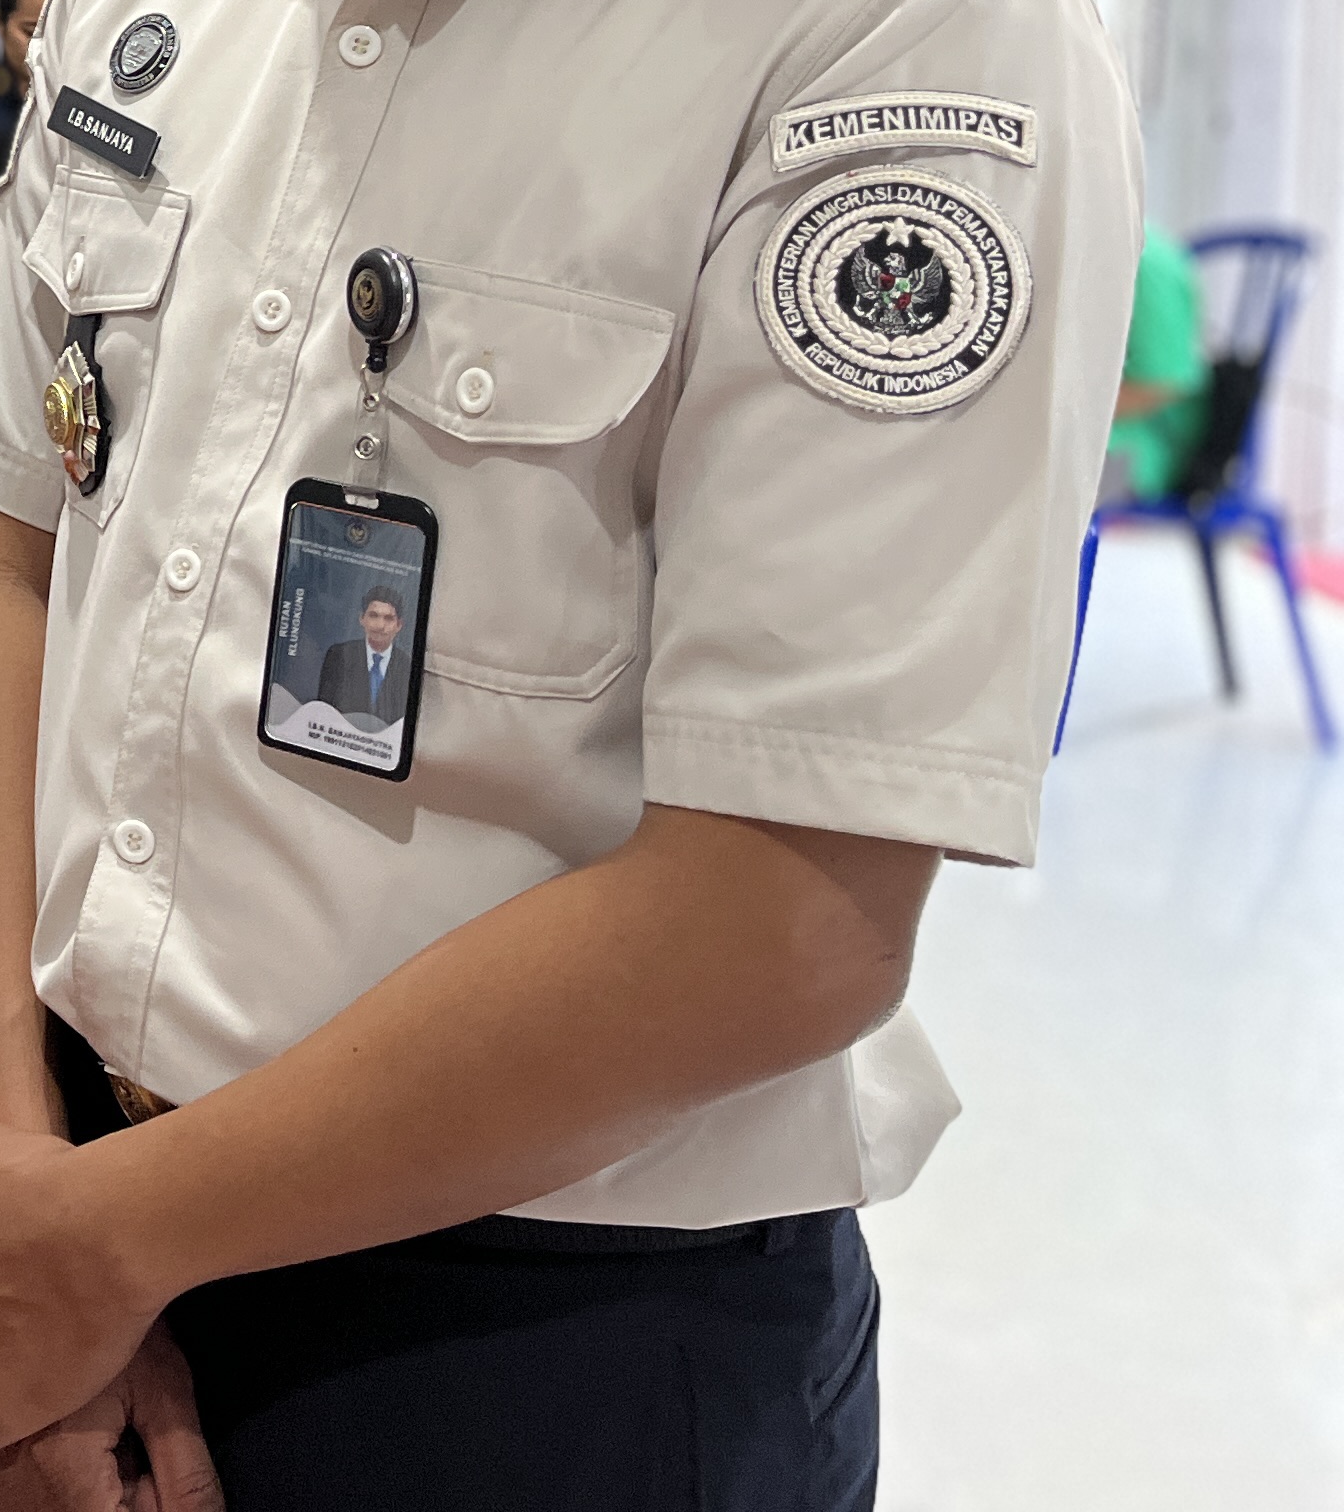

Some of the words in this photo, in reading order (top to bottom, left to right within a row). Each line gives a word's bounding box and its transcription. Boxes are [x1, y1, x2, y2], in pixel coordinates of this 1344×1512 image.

[66, 106, 135, 156] I.B.SANJAYA
[788, 105, 1020, 151] KEMENIMIPAS
[777, 220, 813, 338] KEMENTERIAN
[810, 185, 892, 232] IMIGRASI
[897, 185, 941, 209] DAN
[803, 341, 884, 392] REPUBLIK
[883, 358, 969, 394] INDONESIA
